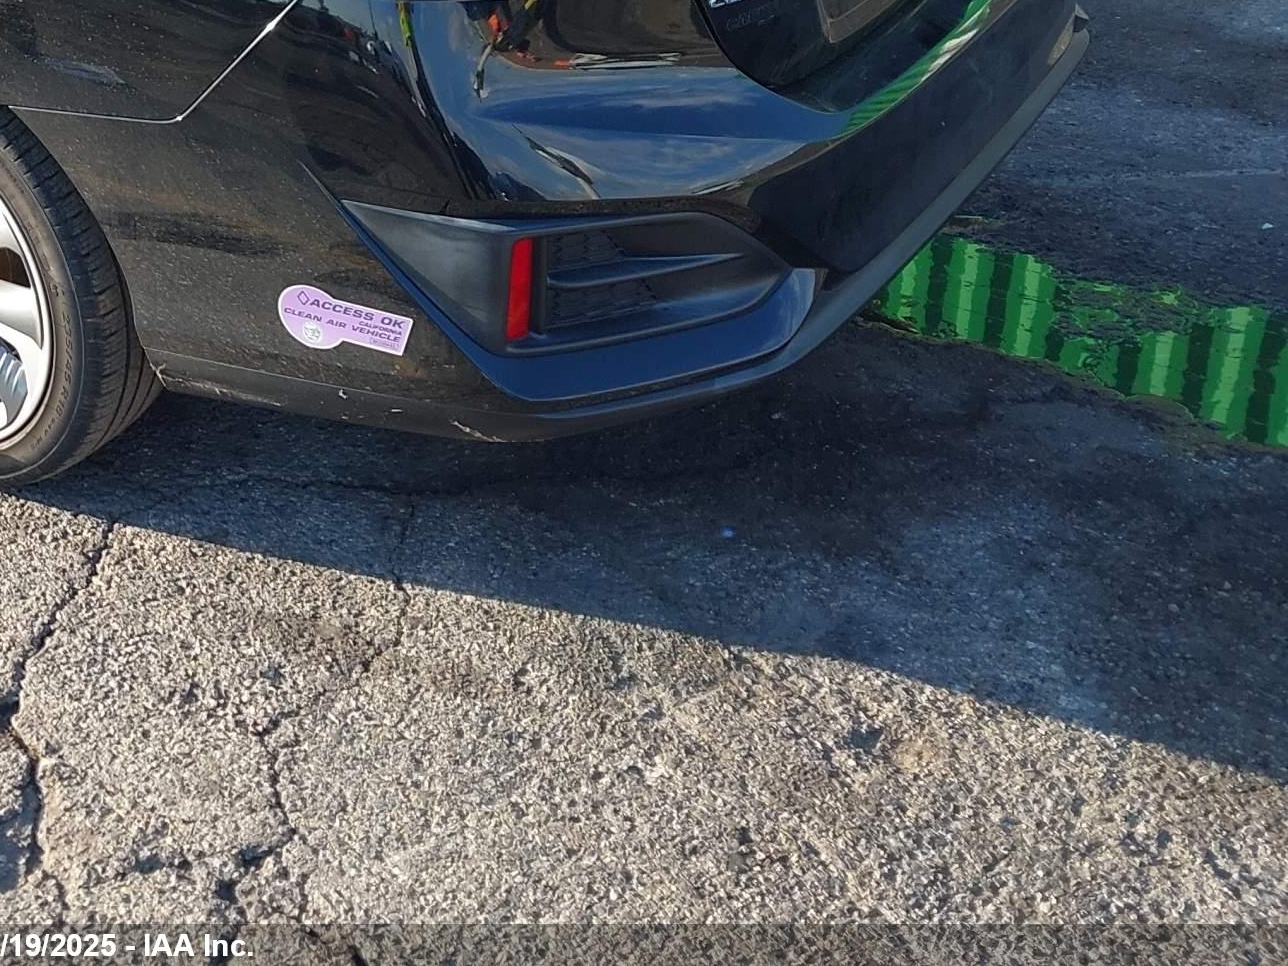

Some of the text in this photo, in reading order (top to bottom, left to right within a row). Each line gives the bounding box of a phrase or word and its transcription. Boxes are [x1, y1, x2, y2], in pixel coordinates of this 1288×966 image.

[283, 307, 401, 342] CLEAN AIR VEHICLE
[310, 298, 406, 329] ACCESS OK
[358, 320, 403, 336] CALIFORNIA
